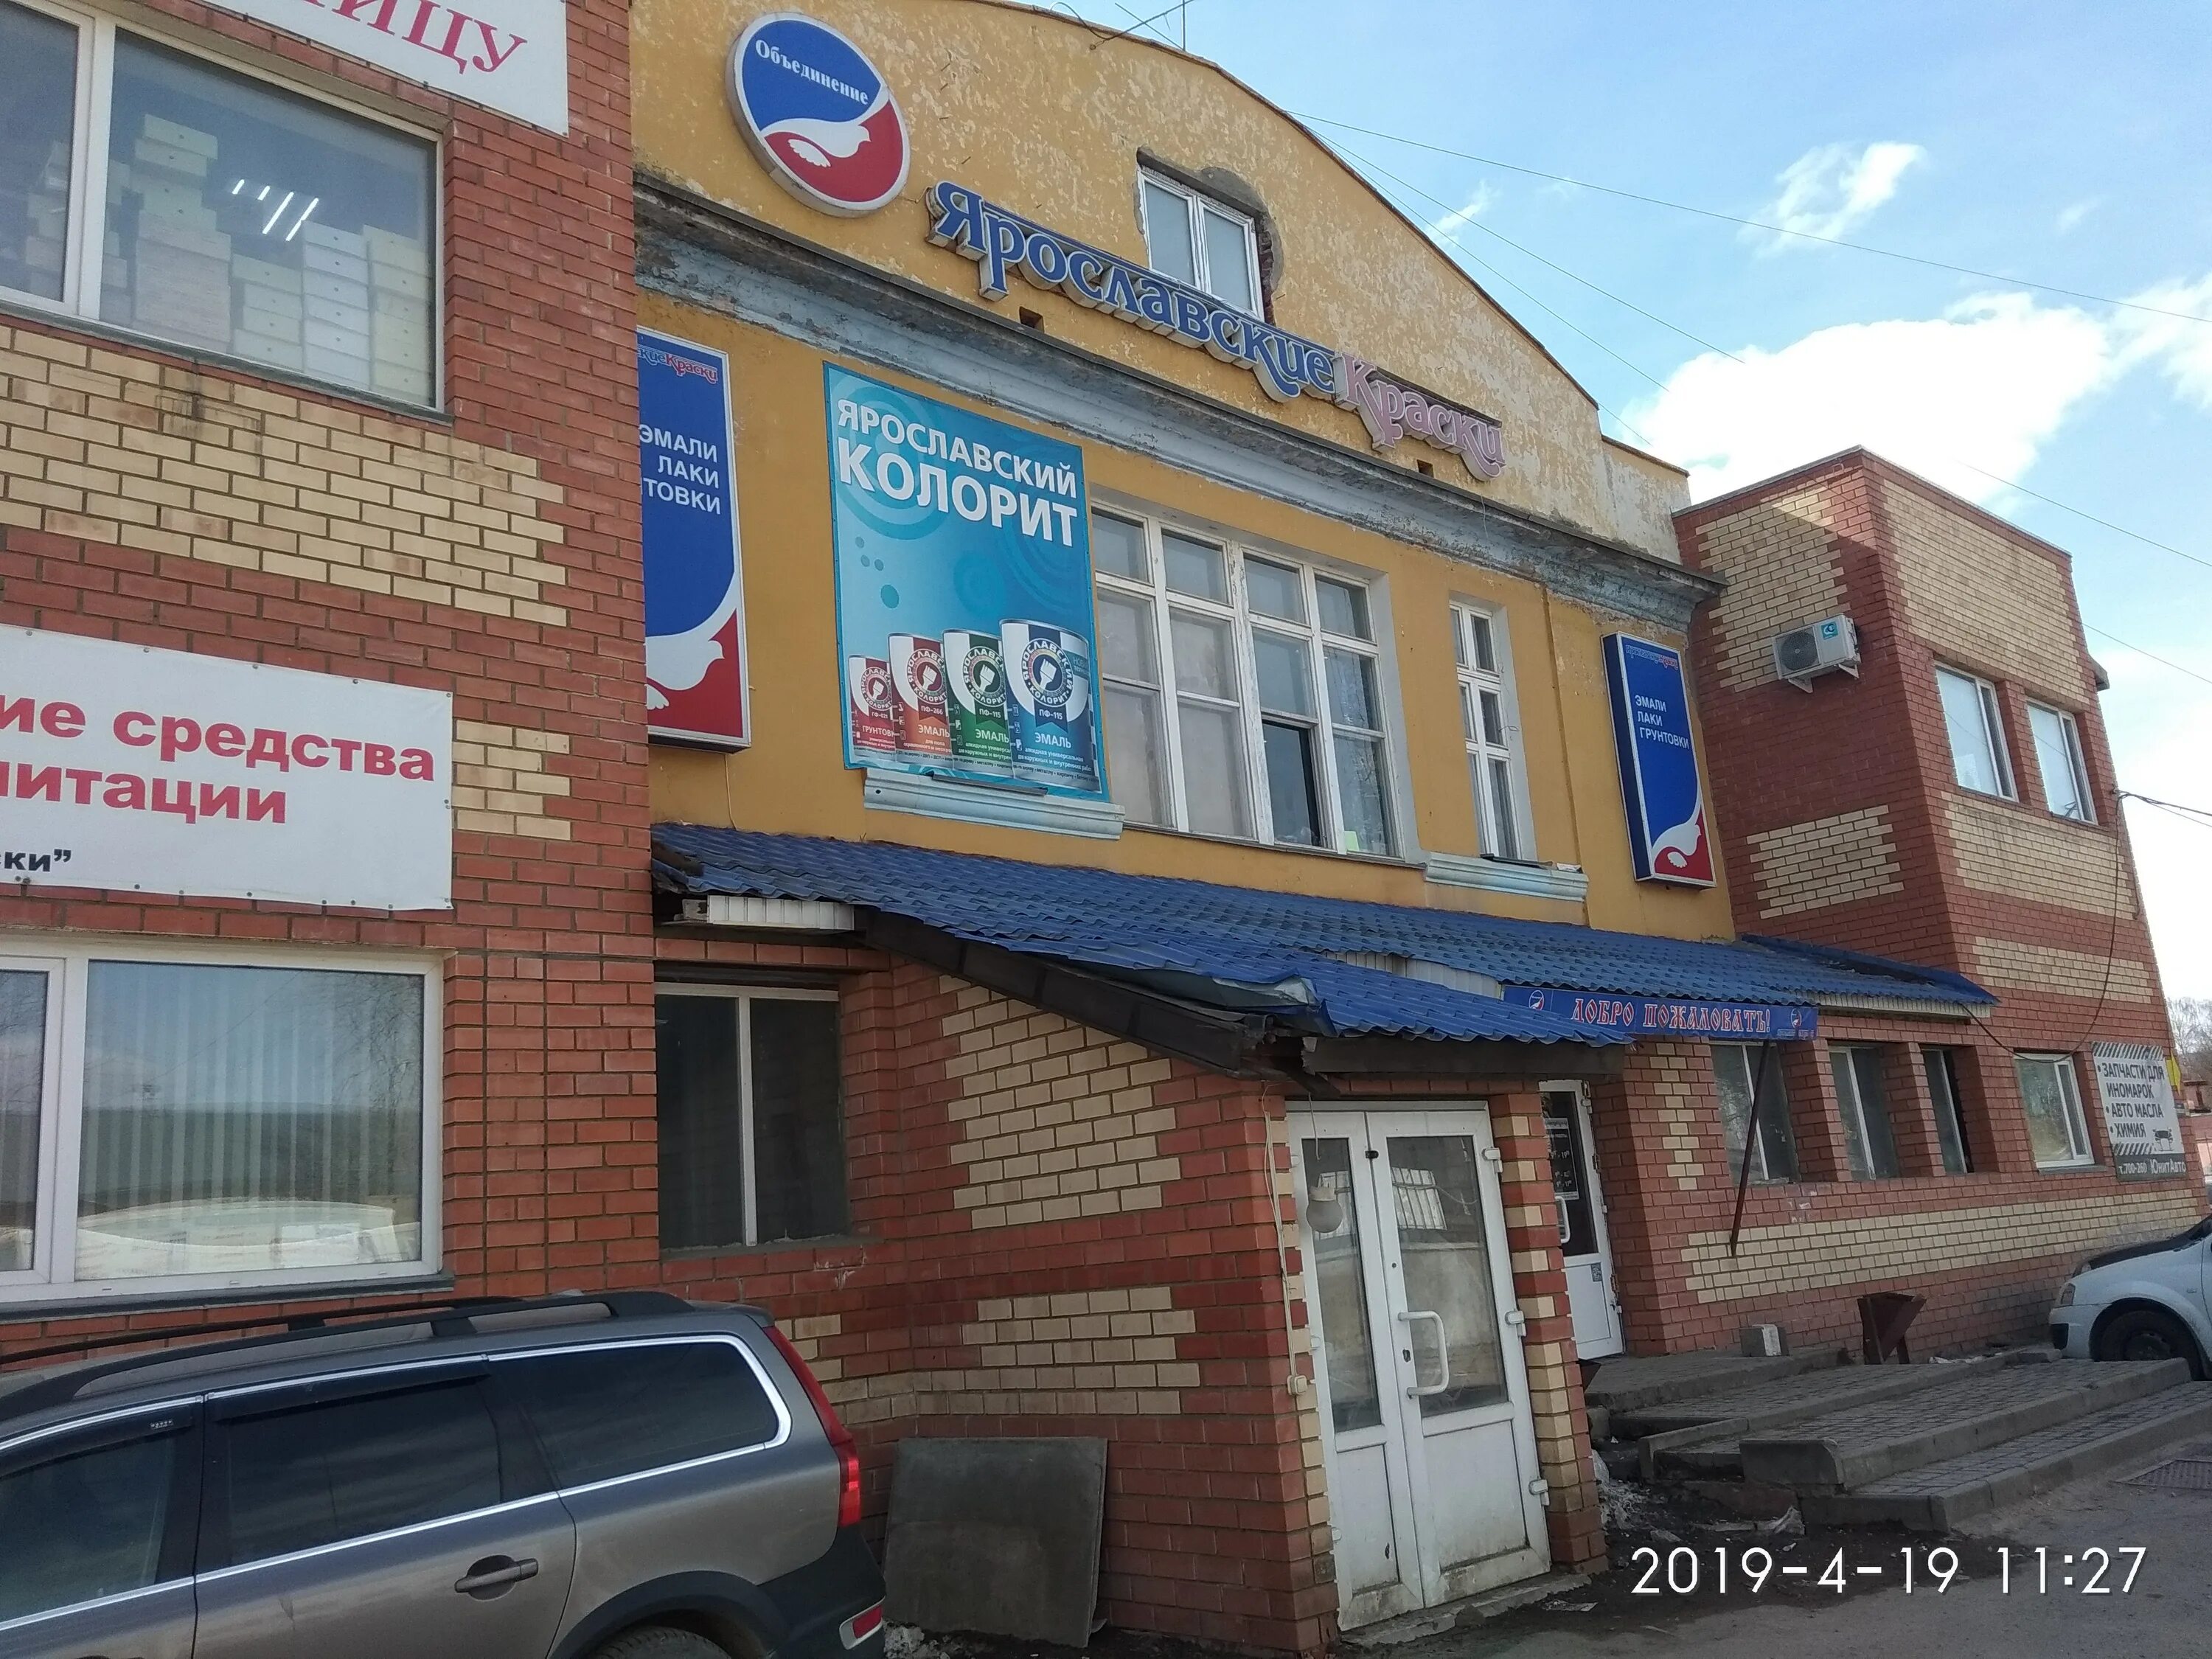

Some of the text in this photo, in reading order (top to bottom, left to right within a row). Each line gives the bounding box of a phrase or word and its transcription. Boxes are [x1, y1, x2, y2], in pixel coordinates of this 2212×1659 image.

[302, 0, 527, 74] ИЦУ
[755, 39, 869, 105] Объединение
[927, 181, 1506, 479] Ярославские Краски
[639, 424, 717, 463] ЭМАЛИ
[838, 399, 1077, 499] ЯРОСЛАВСКИЙ
[658, 455, 719, 489] ЛАКИ
[641, 477, 720, 515] ТОВКИ
[837, 438, 1077, 548] КОЛОРИТ
[1022, 641, 1074, 704] ЯРОСЛАВСКИЙ КОЛОРИТ
[914, 687, 947, 703] КОЛОРИТ
[970, 689, 1006, 705] КОЛОРИТ
[1635, 695, 1666, 713] ЭМАЛИ
[921, 706, 944, 715] ПФ-266
[979, 709, 1001, 718] ПФ-115
[1039, 709, 1062, 720] ПФ-115
[1637, 711, 1663, 727] ЛАКИ
[918, 724, 950, 737] ЭМАЛЬ
[975, 728, 1009, 743] ЭМАЛЬ
[1034, 732, 1071, 748] ЭМАЛЬ
[1639, 727, 1690, 750] ГРУНТОВКИ
[114, 709, 434, 782] средства
[0, 849, 72, 872] ки”
[1571, 998, 1770, 1033] ДОБРО ПОЖАЛОВАТЬ!
[2102, 1062, 2165, 1082] ЗАПЧАСТИ ДЛЯ
[2107, 1082, 2154, 1099] ИНОМАРОК
[2112, 1103, 2164, 1119] АВТО МАСЛА
[2115, 1122, 2146, 1138] ХИМИЯ
